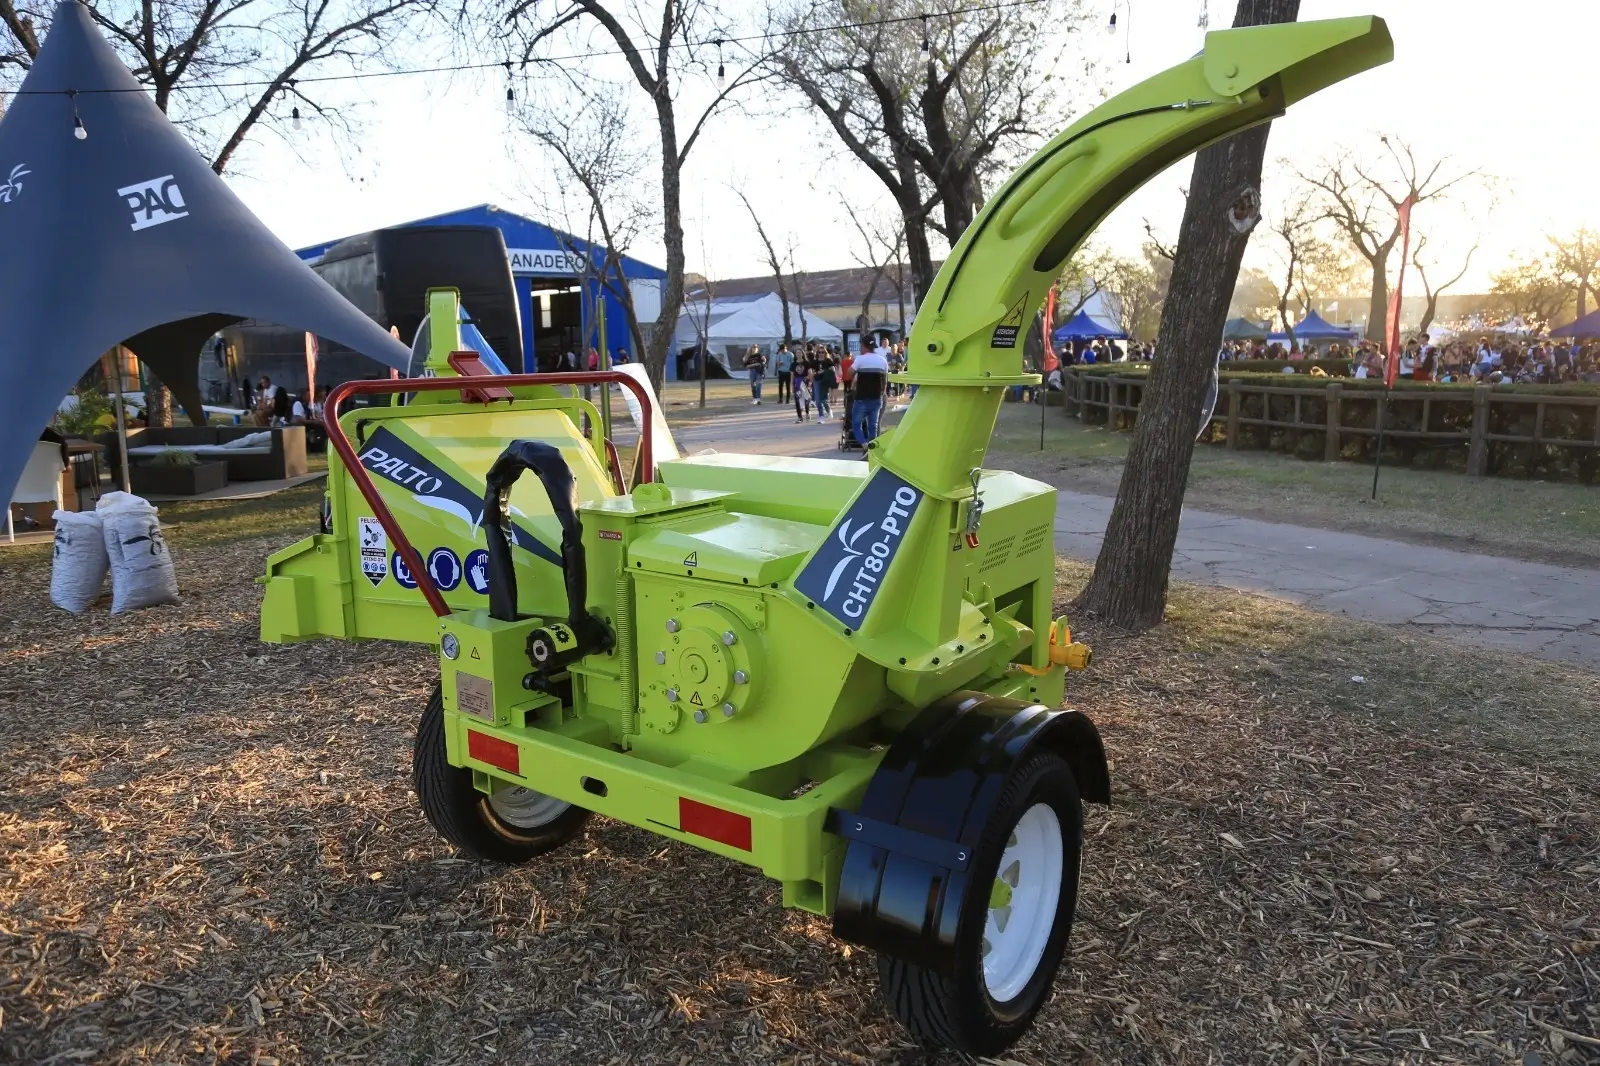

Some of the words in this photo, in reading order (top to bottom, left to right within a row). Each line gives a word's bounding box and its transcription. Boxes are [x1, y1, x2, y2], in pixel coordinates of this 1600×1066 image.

[120, 177, 188, 226] PAC
[511, 253, 586, 269] ANADERO
[359, 447, 443, 494] PALTO
[360, 517, 380, 525] PELIGR
[842, 486, 917, 618] CHT80-PTO
